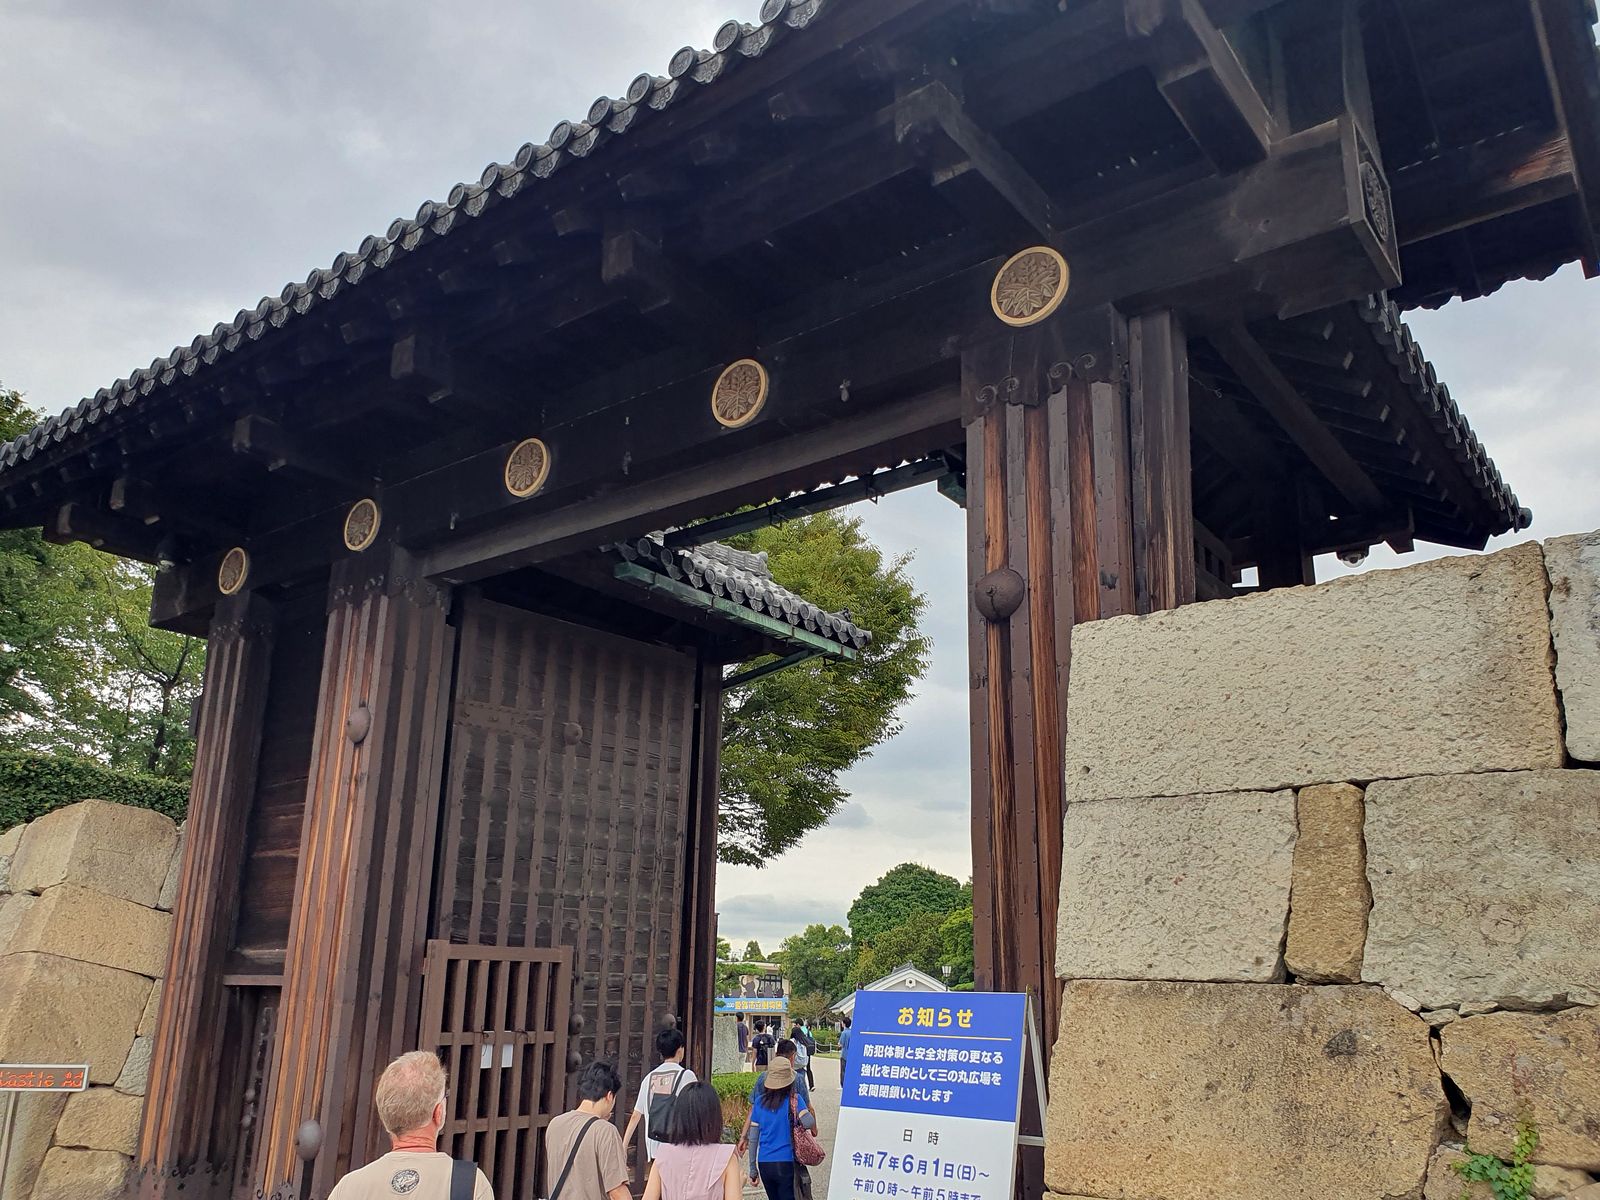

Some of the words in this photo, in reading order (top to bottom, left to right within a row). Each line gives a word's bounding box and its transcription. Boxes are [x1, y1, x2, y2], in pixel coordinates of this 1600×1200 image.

[897, 1007, 974, 1028] お知らせ
[863, 1044, 1004, 1065] 防犯体制と安全対策の更なる
[860, 1063, 1002, 1086] 強化を目的として三の丸広場を
[858, 1083, 953, 1103] 夜間閉鎖いたします
